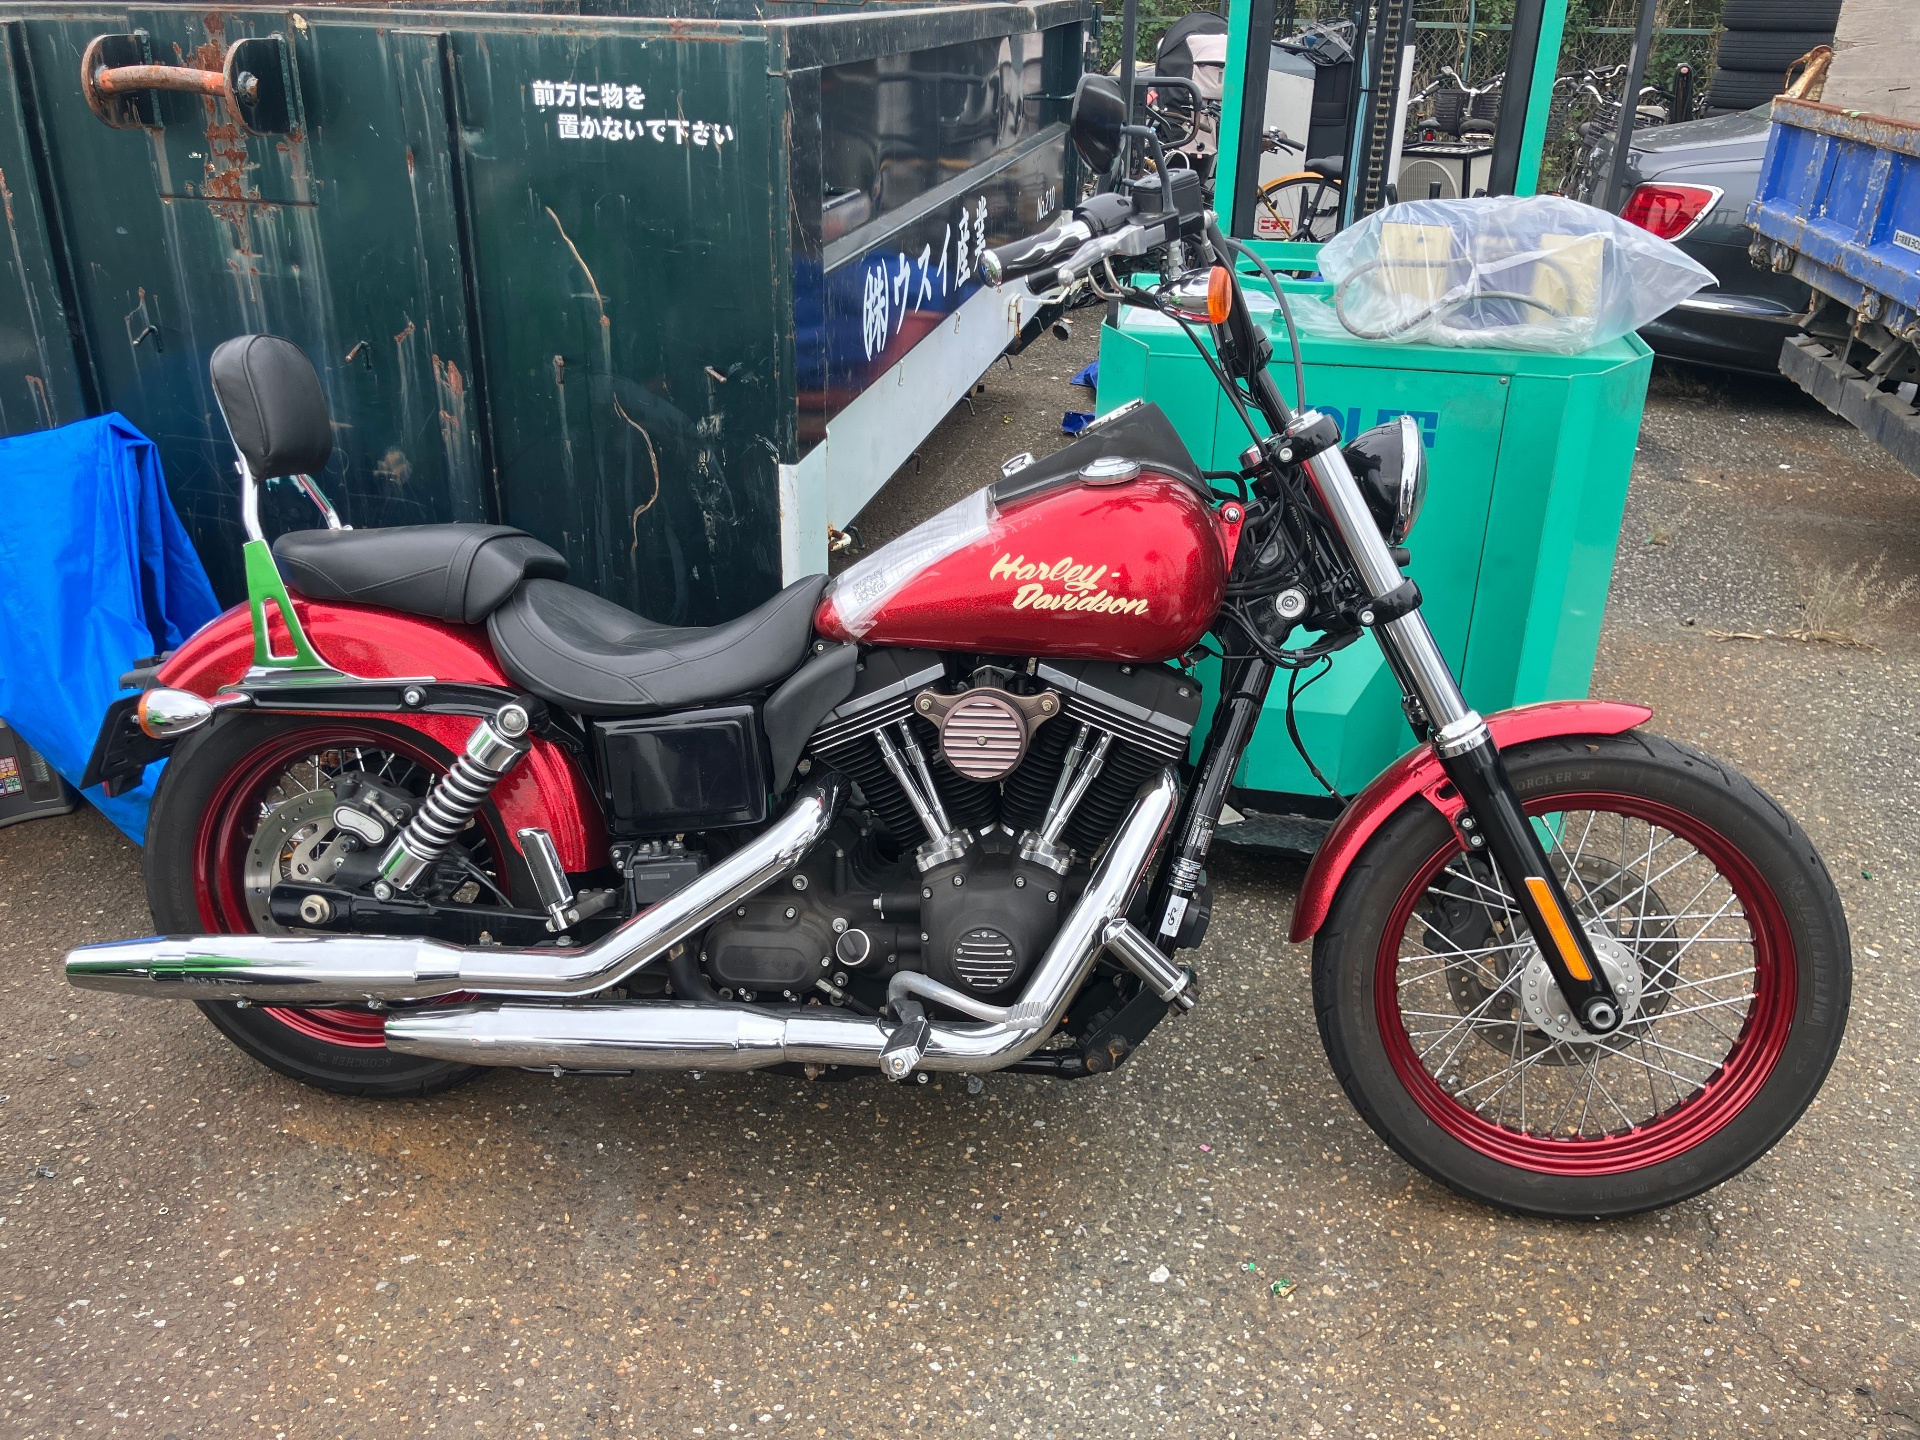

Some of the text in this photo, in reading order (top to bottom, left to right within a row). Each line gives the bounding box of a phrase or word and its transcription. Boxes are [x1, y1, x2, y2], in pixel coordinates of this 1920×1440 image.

[532, 80, 646, 110] 前方に物を
[557, 112, 735, 146] 置かないで下さい
[1012, 583, 1149, 616] Davidson
